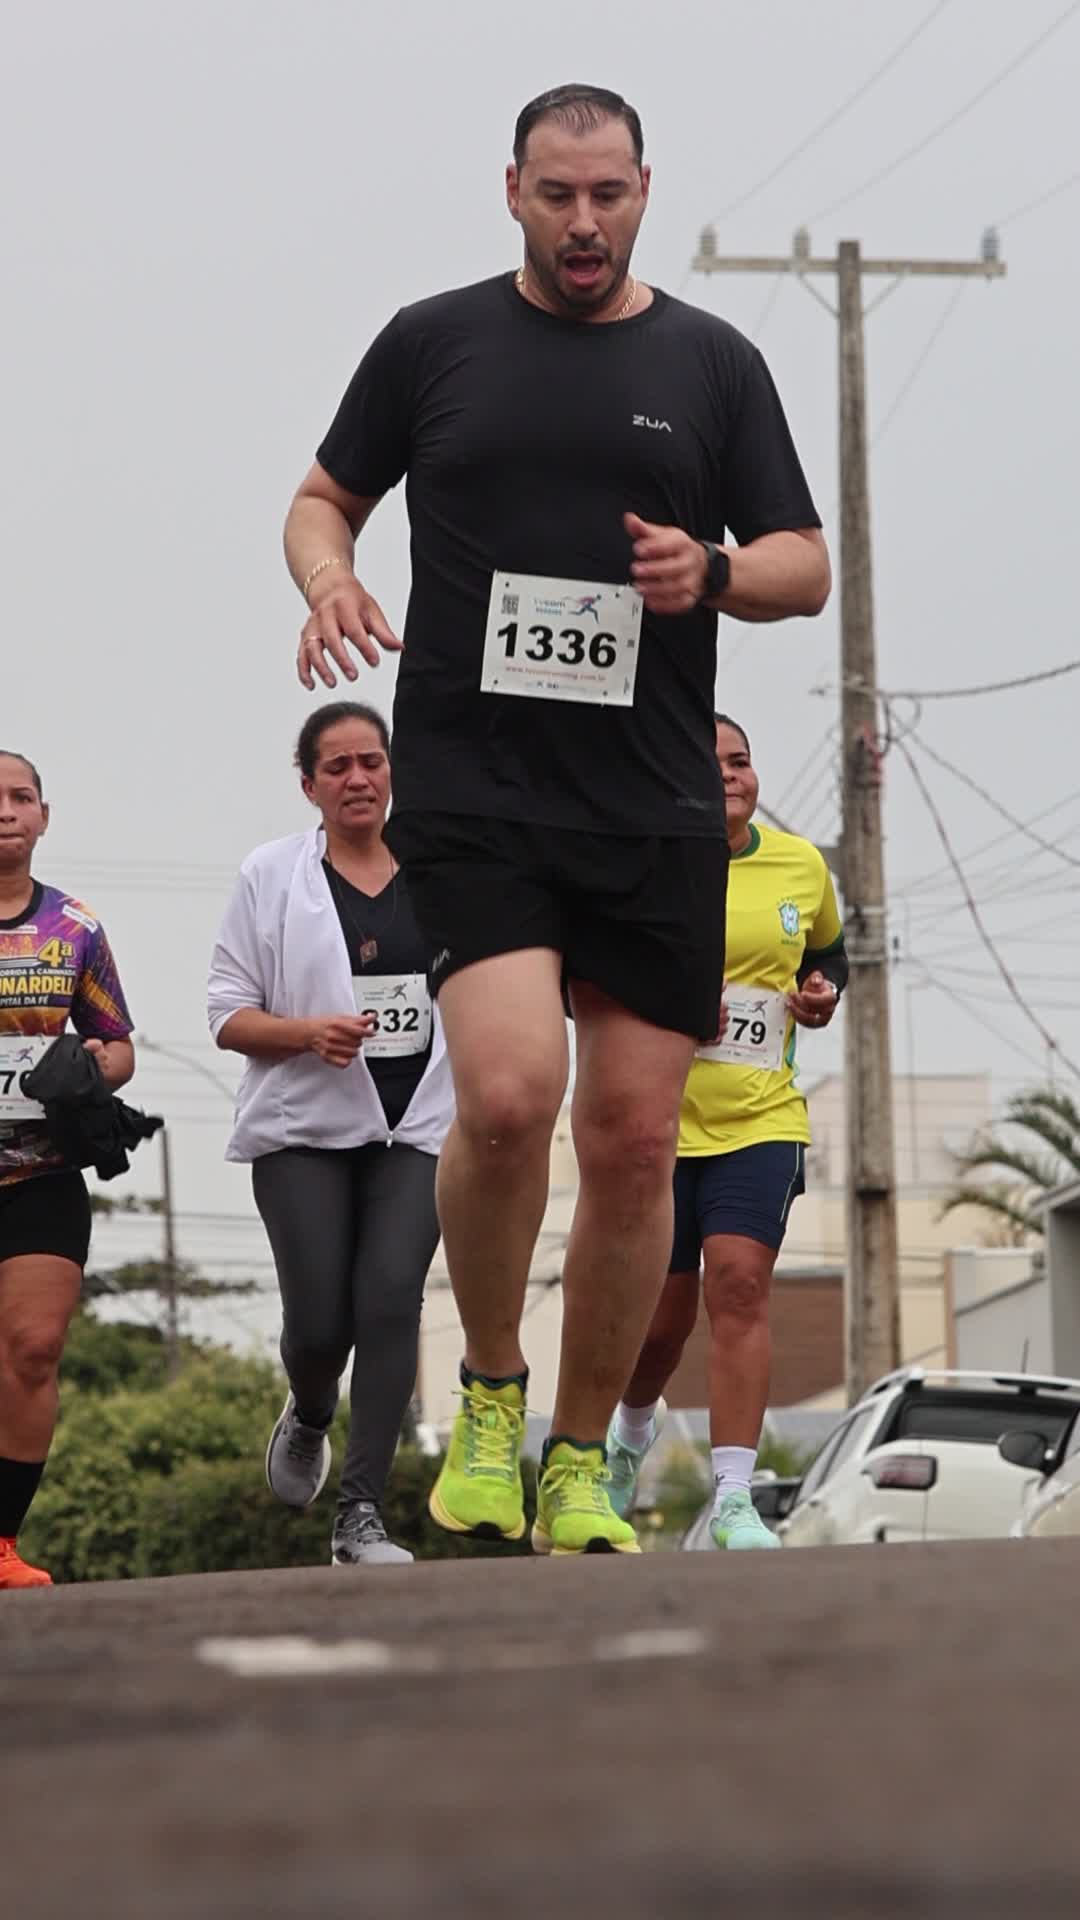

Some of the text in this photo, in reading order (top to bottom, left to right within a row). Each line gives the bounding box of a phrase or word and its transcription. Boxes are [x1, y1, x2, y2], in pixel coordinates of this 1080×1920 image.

[497, 621, 617, 669] 1336
[24, 996, 36, 1005] DA
[728, 1016, 766, 1045] 79
